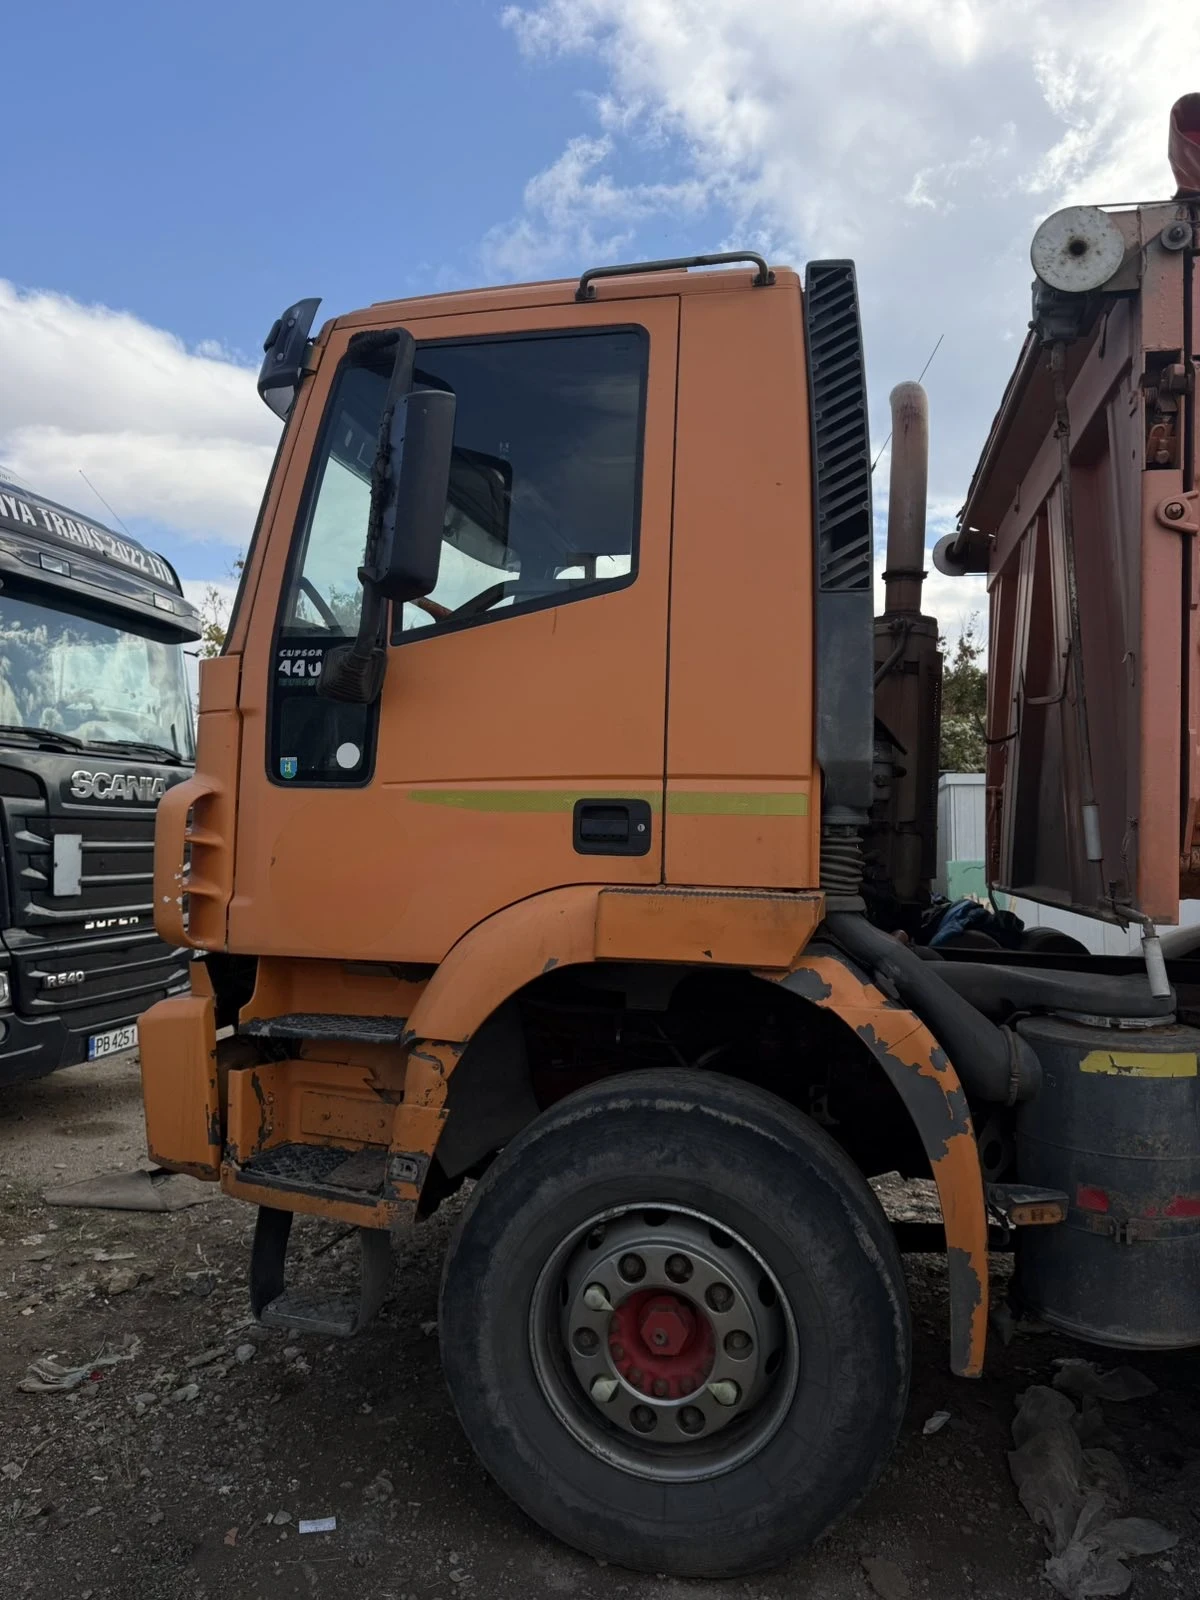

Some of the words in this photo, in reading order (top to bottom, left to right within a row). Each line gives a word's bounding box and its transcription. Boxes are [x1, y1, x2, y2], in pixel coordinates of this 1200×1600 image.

[36, 507, 105, 552] TRANS
[105, 535, 149, 573] 2022
[70, 770, 167, 802] SCANIA
[47, 971, 85, 989] R540
[96, 1035, 110, 1054] PB
[112, 1027, 135, 1049] 4251
